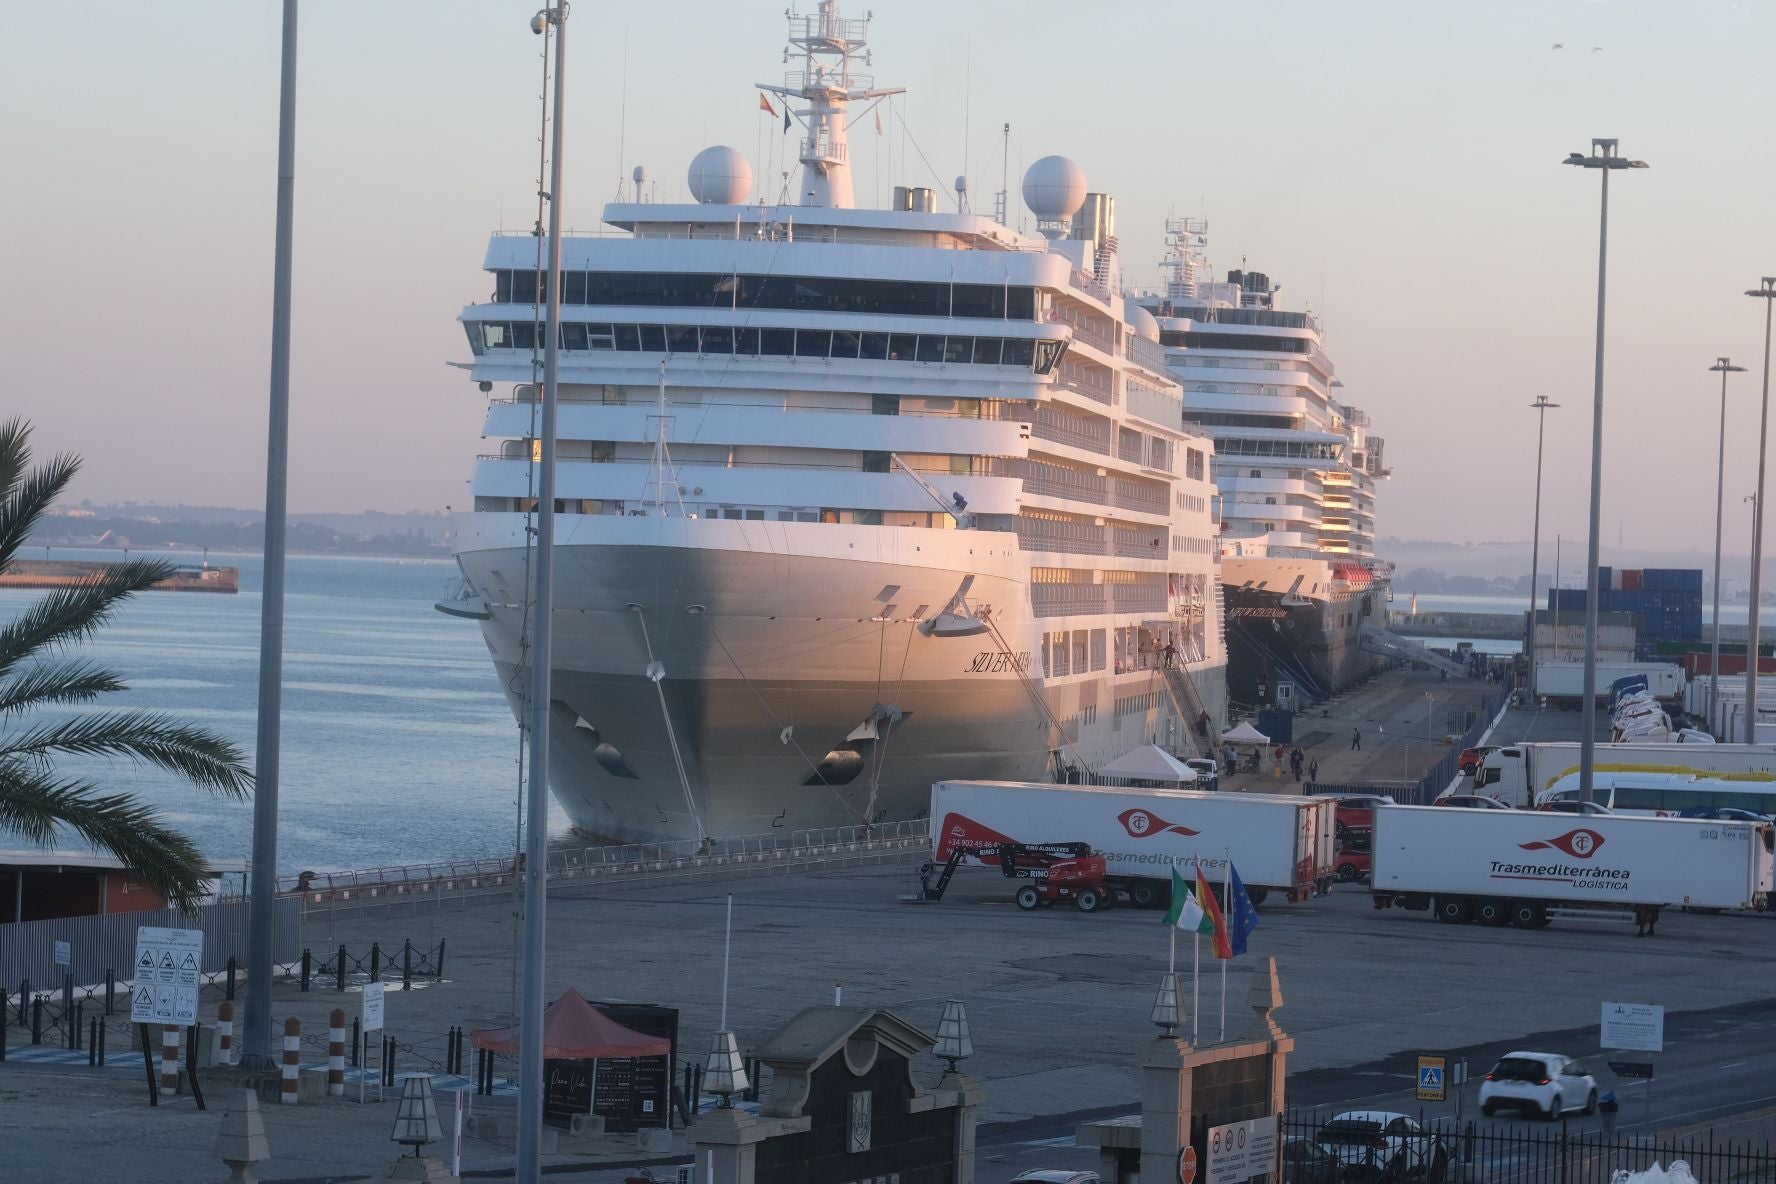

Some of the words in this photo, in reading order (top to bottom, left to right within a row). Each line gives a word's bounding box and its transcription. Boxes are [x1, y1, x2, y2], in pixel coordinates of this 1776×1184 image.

[963, 651, 1009, 674] SILVER
[961, 839, 974, 847] 902
[974, 840, 983, 848] 45
[1030, 870, 1049, 878] RINO
[1490, 861, 1630, 879] Trasmediterránea
[1572, 879, 1629, 891] LOGÍSTICA
[1182, 1161, 1195, 1171] STOP
